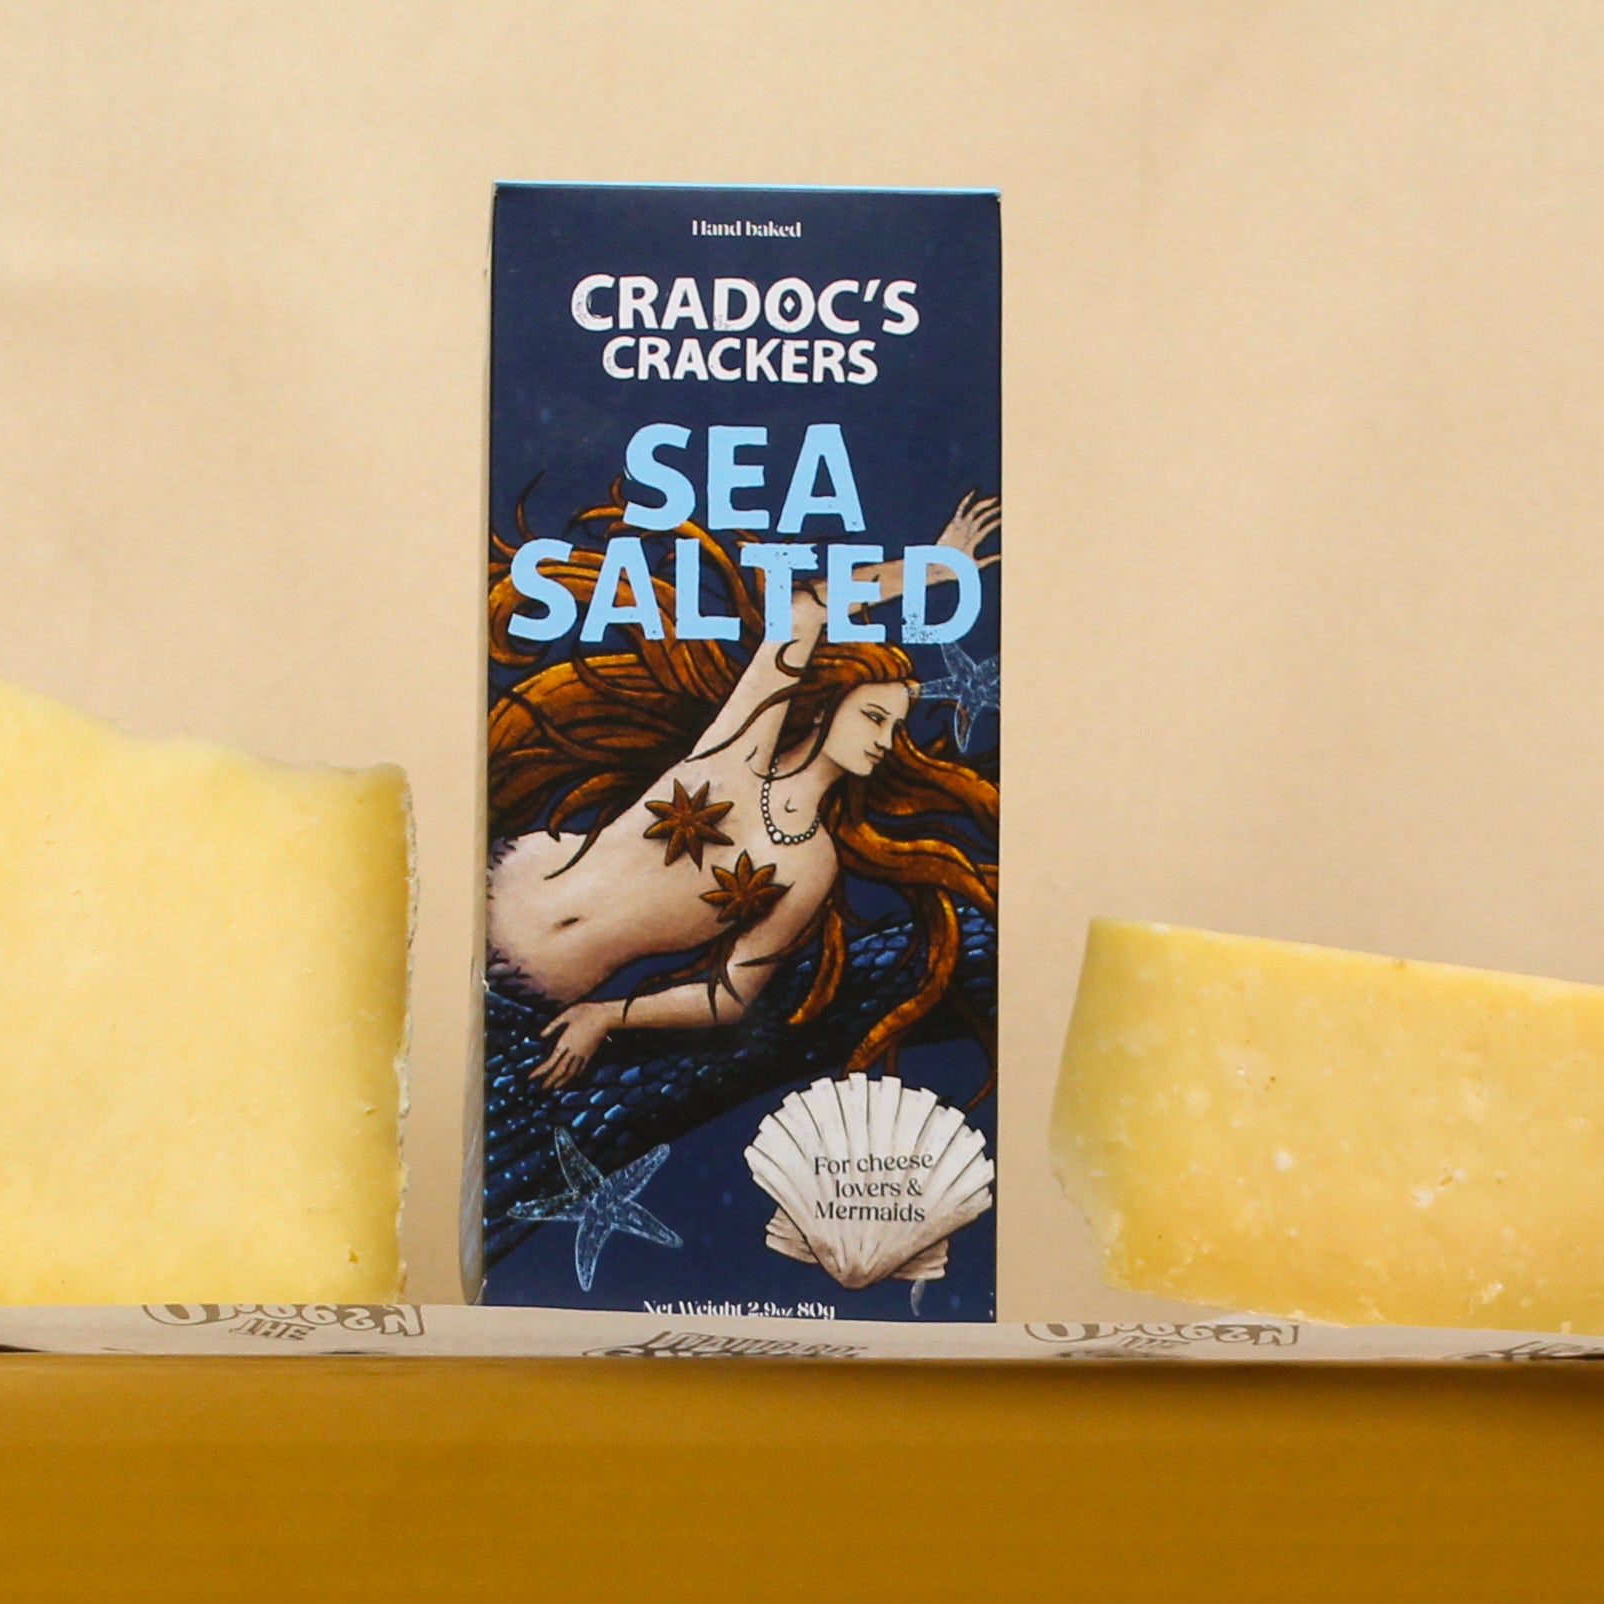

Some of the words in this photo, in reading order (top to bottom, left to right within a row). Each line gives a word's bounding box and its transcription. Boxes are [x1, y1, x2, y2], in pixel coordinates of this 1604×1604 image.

[692, 219, 742, 236] Hand
[745, 220, 802, 238] baked
[571, 274, 920, 335] CRADOC'S
[602, 336, 878, 385] CRACKERS
[623, 423, 866, 533] SEA
[507, 536, 982, 645] SALTED
[814, 1156, 850, 1175] For
[856, 1153, 933, 1173] cheese
[835, 1179, 901, 1198] lovers
[907, 1178, 923, 1196] &
[815, 1200, 925, 1222] Mermaids
